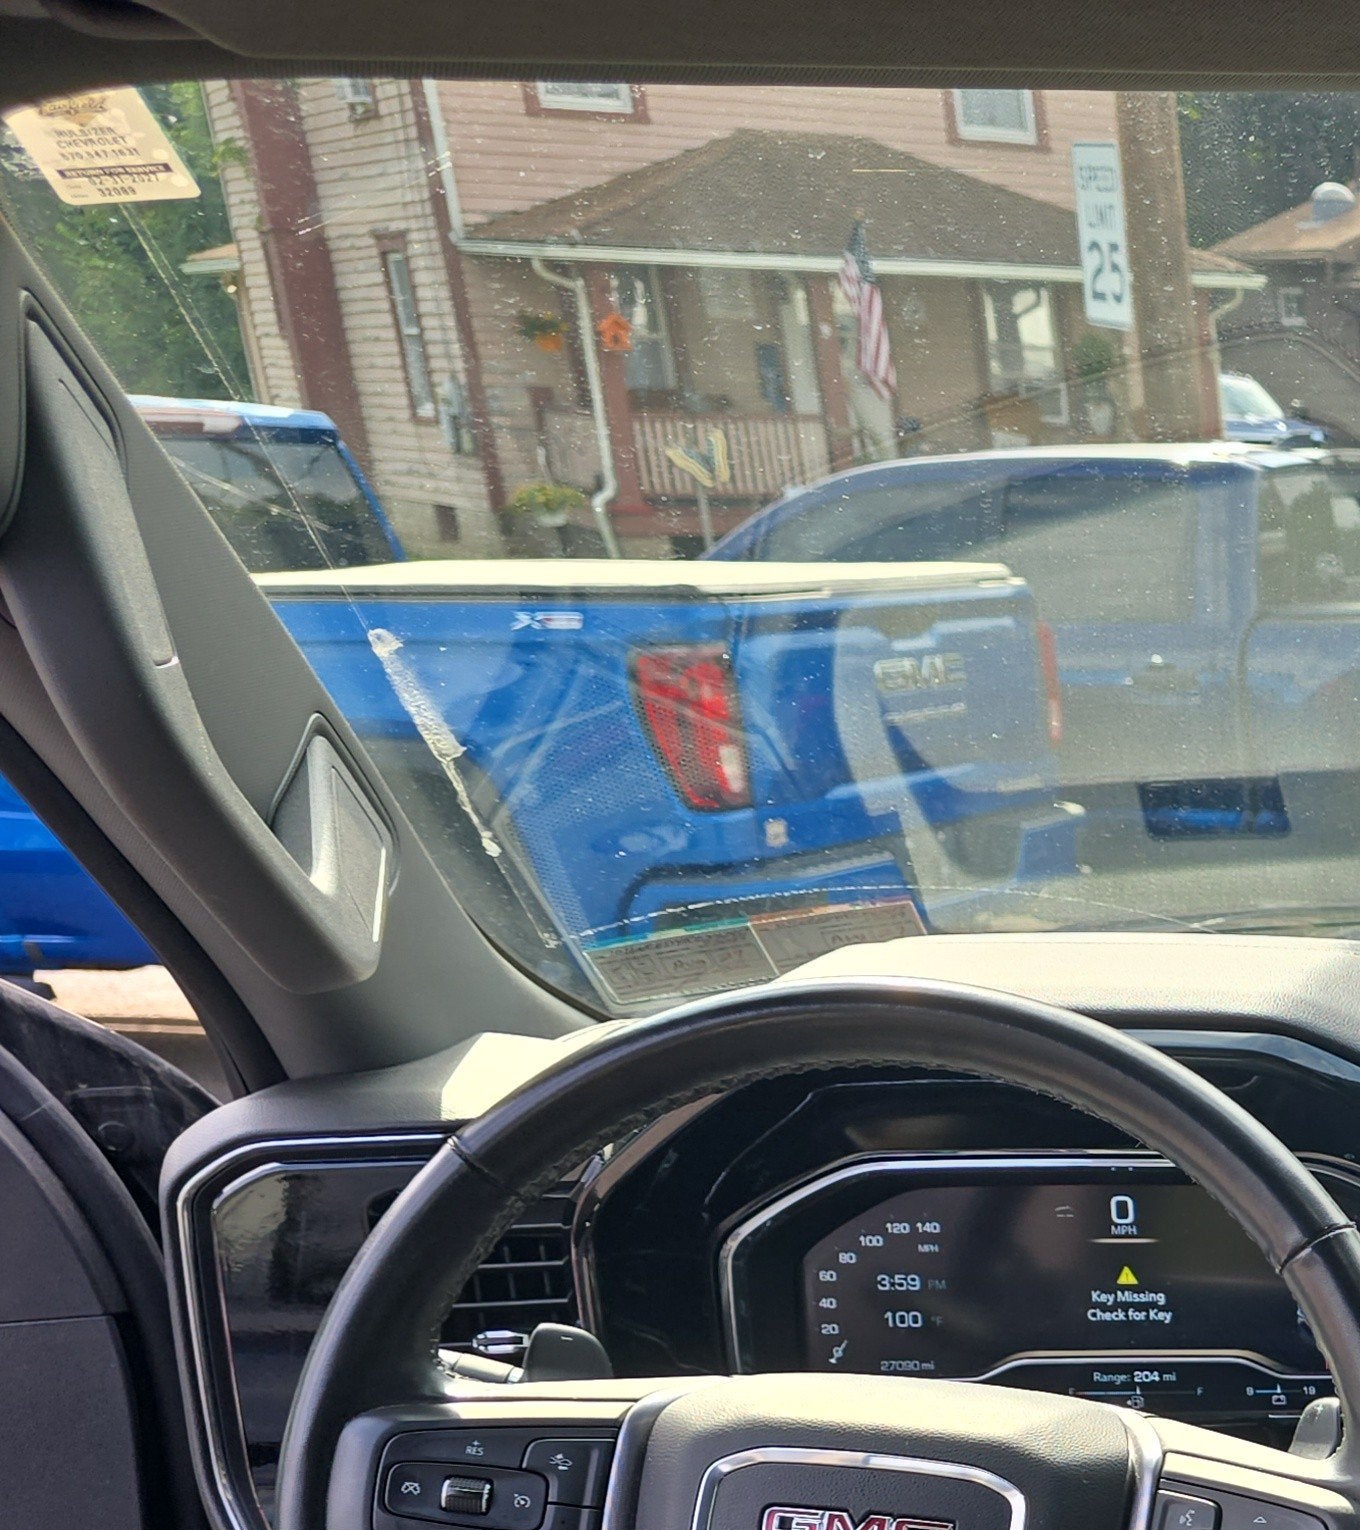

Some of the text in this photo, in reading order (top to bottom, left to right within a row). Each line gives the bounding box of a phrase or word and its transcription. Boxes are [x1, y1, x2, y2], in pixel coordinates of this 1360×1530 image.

[57, 136, 129, 150] CHEVROLET
[1086, 239, 1124, 305] 25
[1110, 1194, 1136, 1225] 0
[886, 1222, 911, 1235] 120
[916, 1221, 941, 1234] 140
[1110, 1224, 1138, 1236] MPH
[859, 1235, 884, 1248] 100
[918, 1244, 940, 1254] MPH
[838, 1252, 857, 1264] 80
[818, 1270, 838, 1282] 60
[876, 1273, 947, 1292] 3:59 PM
[818, 1297, 838, 1310] 40
[1091, 1290, 1167, 1305] Key Missing
[884, 1310, 923, 1328] 100
[1087, 1309, 1174, 1324] Check for Key
[820, 1323, 840, 1336] 20
[1093, 1370, 1177, 1385] Range: 204 mi
[1302, 1385, 1317, 1396] 19
[464, 1445, 485, 1457] RES
